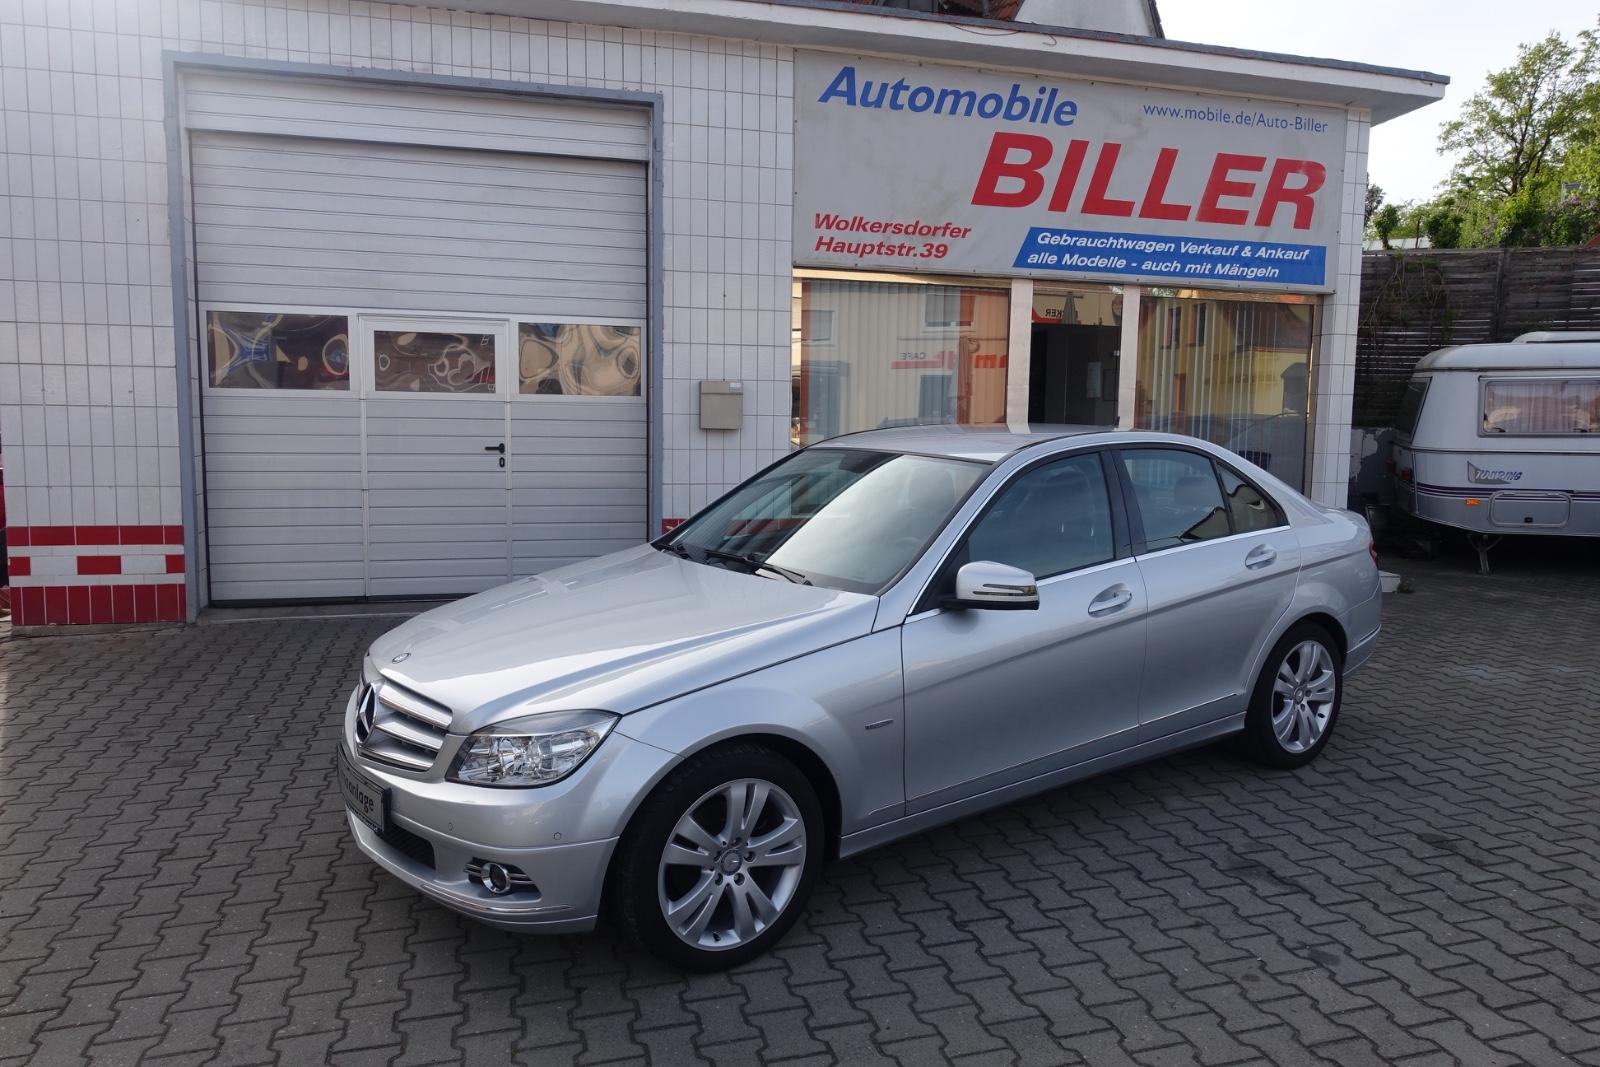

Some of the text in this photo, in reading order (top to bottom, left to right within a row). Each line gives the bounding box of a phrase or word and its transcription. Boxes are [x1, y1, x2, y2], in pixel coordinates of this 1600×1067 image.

[817, 66, 1078, 127] Automobile
[1143, 104, 1328, 133] www.mobile.de/Auto-Biller
[970, 131, 1327, 230] BILLER
[814, 213, 972, 239] Wolkersdorfer
[815, 235, 949, 259] Hauptstr.39
[1037, 232, 1309, 261] Gebrauchtwagen Verkauf & Ankauf
[1028, 252, 1058, 264] alle
[1061, 253, 1127, 269] Modelle
[1142, 259, 1181, 273] auch
[1185, 262, 1211, 274] mit
[1214, 264, 1279, 279] Mängeln
